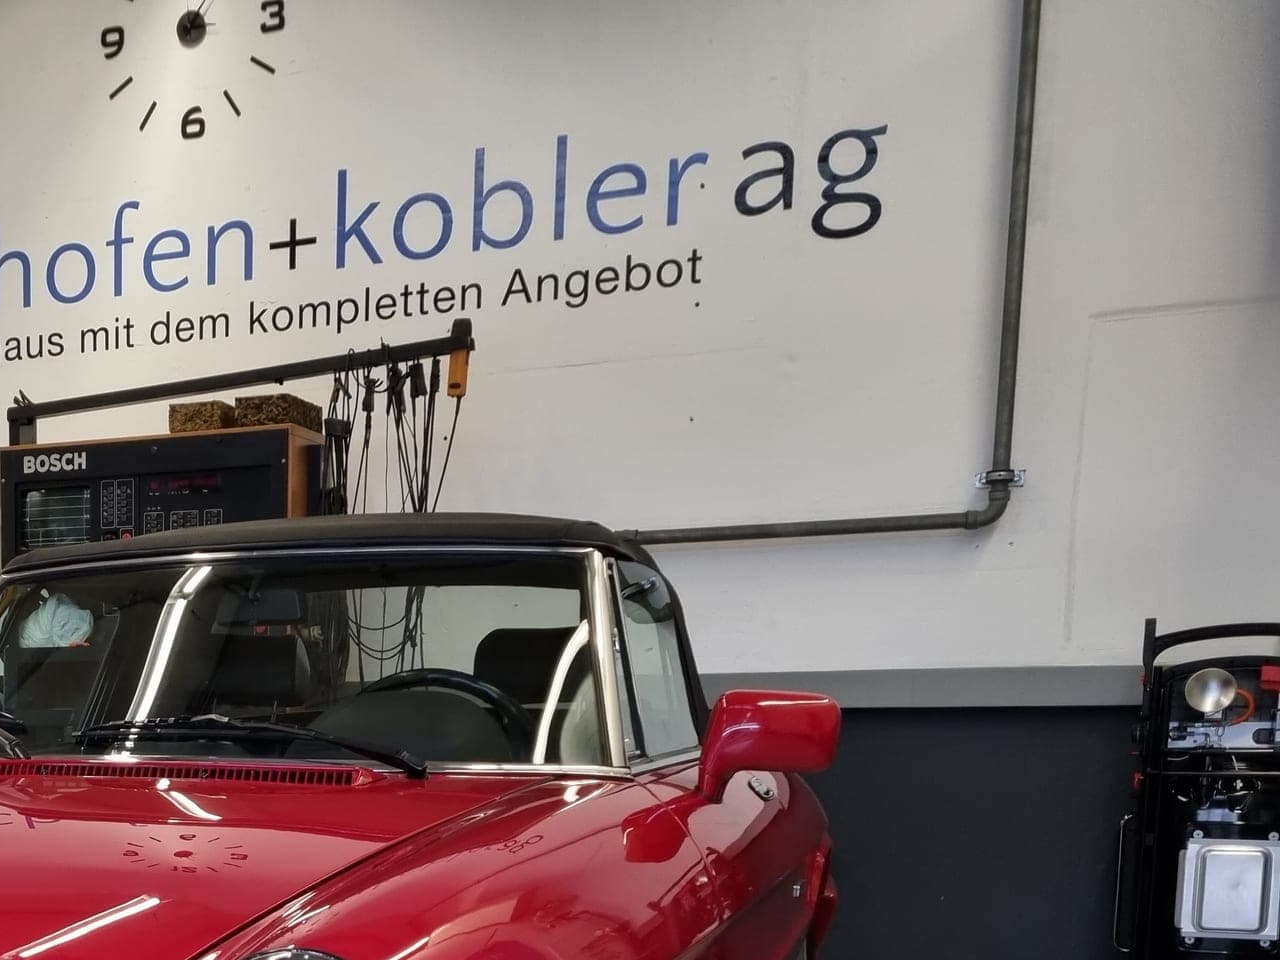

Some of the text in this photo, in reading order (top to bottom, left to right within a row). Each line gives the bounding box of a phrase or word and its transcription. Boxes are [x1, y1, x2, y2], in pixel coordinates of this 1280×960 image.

[260, 0, 286, 34] 3
[100, 25, 125, 60] 9
[180, 106, 206, 140] 6
[734, 124, 888, 240] ag
[80, 317, 135, 354] mit
[150, 311, 230, 346] dem
[249, 282, 482, 335] kompletten
[500, 248, 703, 309] Angebot
[23, 451, 87, 474] BOSCH
